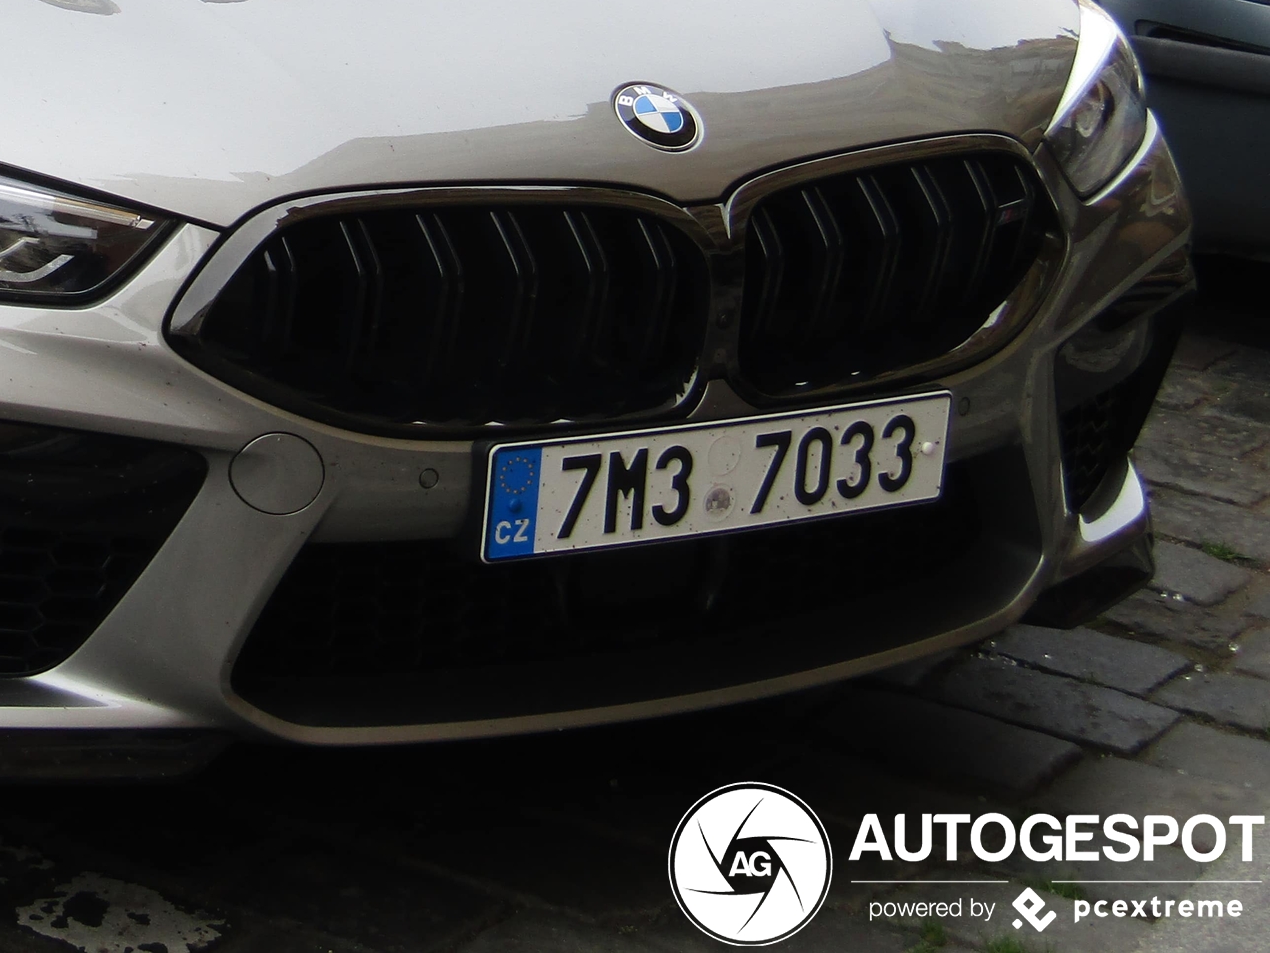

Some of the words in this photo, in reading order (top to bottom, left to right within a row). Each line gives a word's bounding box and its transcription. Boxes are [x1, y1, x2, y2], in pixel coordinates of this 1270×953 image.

[618, 86, 678, 107] BMW
[556, 445, 694, 539] 7M3
[750, 414, 917, 515] 7033
[494, 518, 530, 545] CZ
